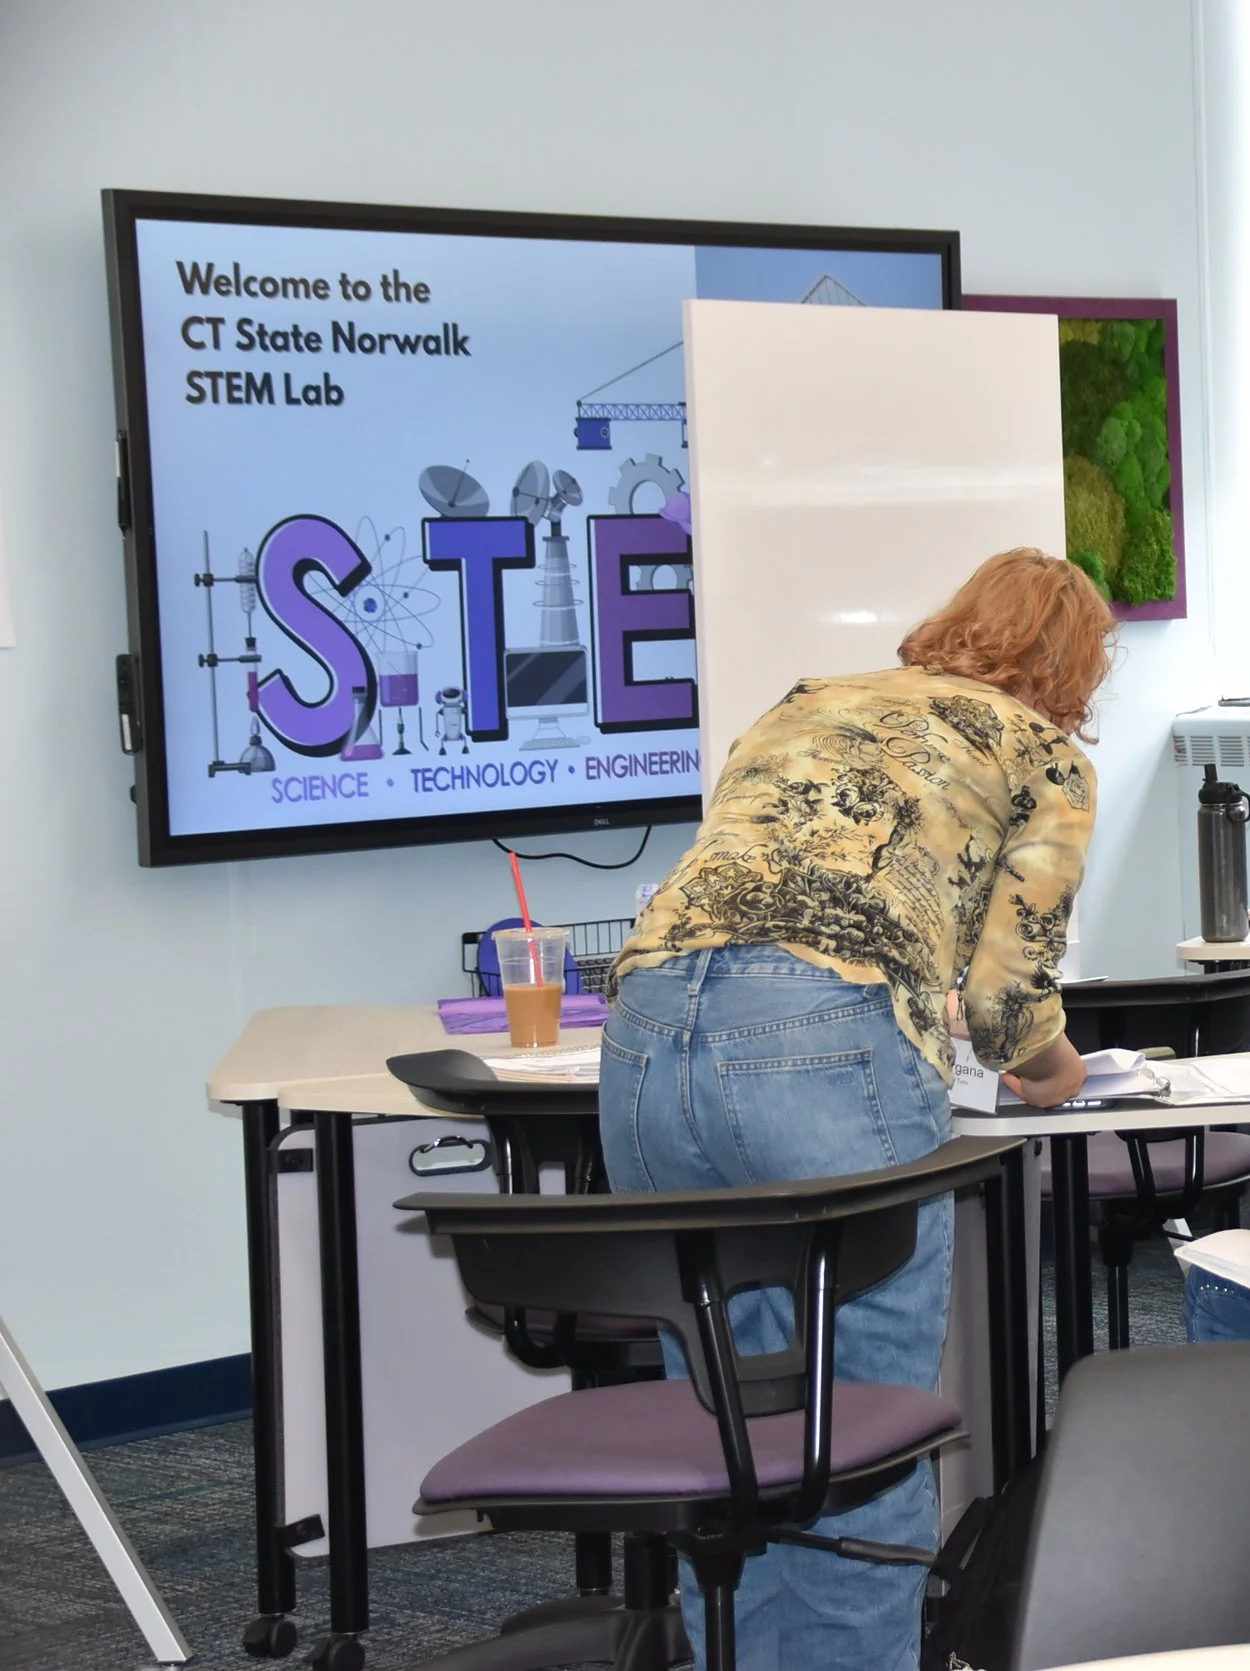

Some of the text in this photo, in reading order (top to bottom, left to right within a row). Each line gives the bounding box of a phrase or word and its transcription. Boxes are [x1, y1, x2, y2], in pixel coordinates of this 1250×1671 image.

[175, 259, 431, 304] Welcome to the
[181, 315, 472, 357] CT State Norwalk
[185, 369, 345, 407] STEM Lab
[271, 748, 702, 804] SCIENCE TECHNOLOGY ENGINEERIN
[954, 1064, 984, 1078] gana
